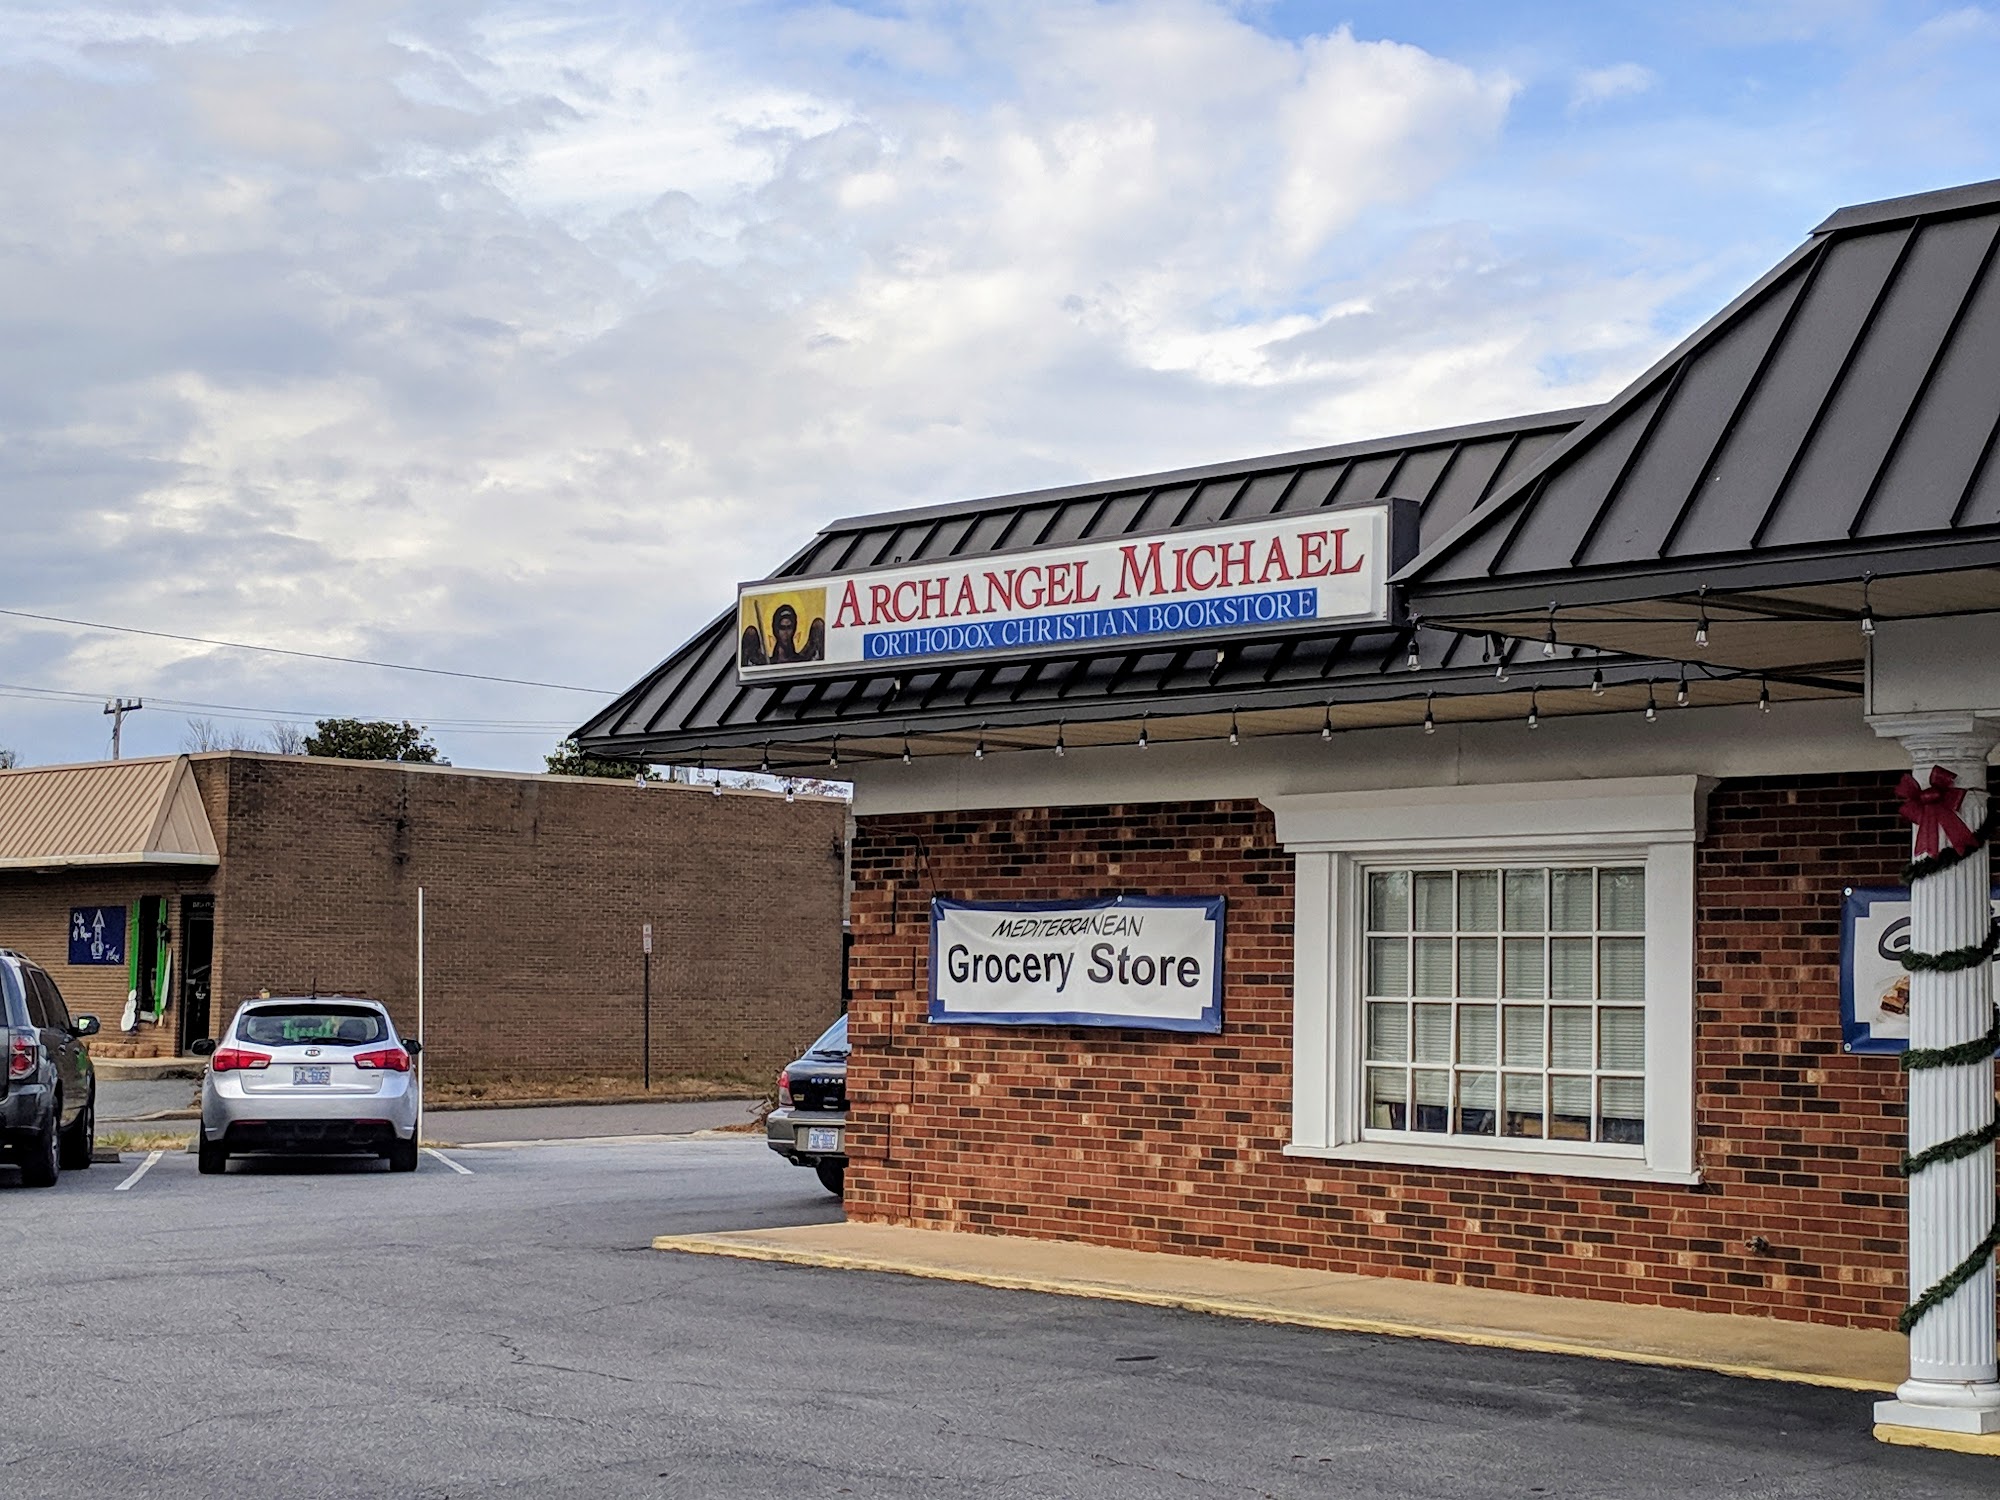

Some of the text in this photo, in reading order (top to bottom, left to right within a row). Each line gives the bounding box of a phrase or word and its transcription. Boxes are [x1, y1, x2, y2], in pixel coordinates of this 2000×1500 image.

[832, 528, 1364, 629] ARCHANGEL MICHAEL
[870, 590, 1316, 658] ORTHODOX CHRISTIAN BOOKSTORE
[991, 913, 1144, 938] MEDITERRANEAN
[948, 942, 1201, 993] Grocery Store
